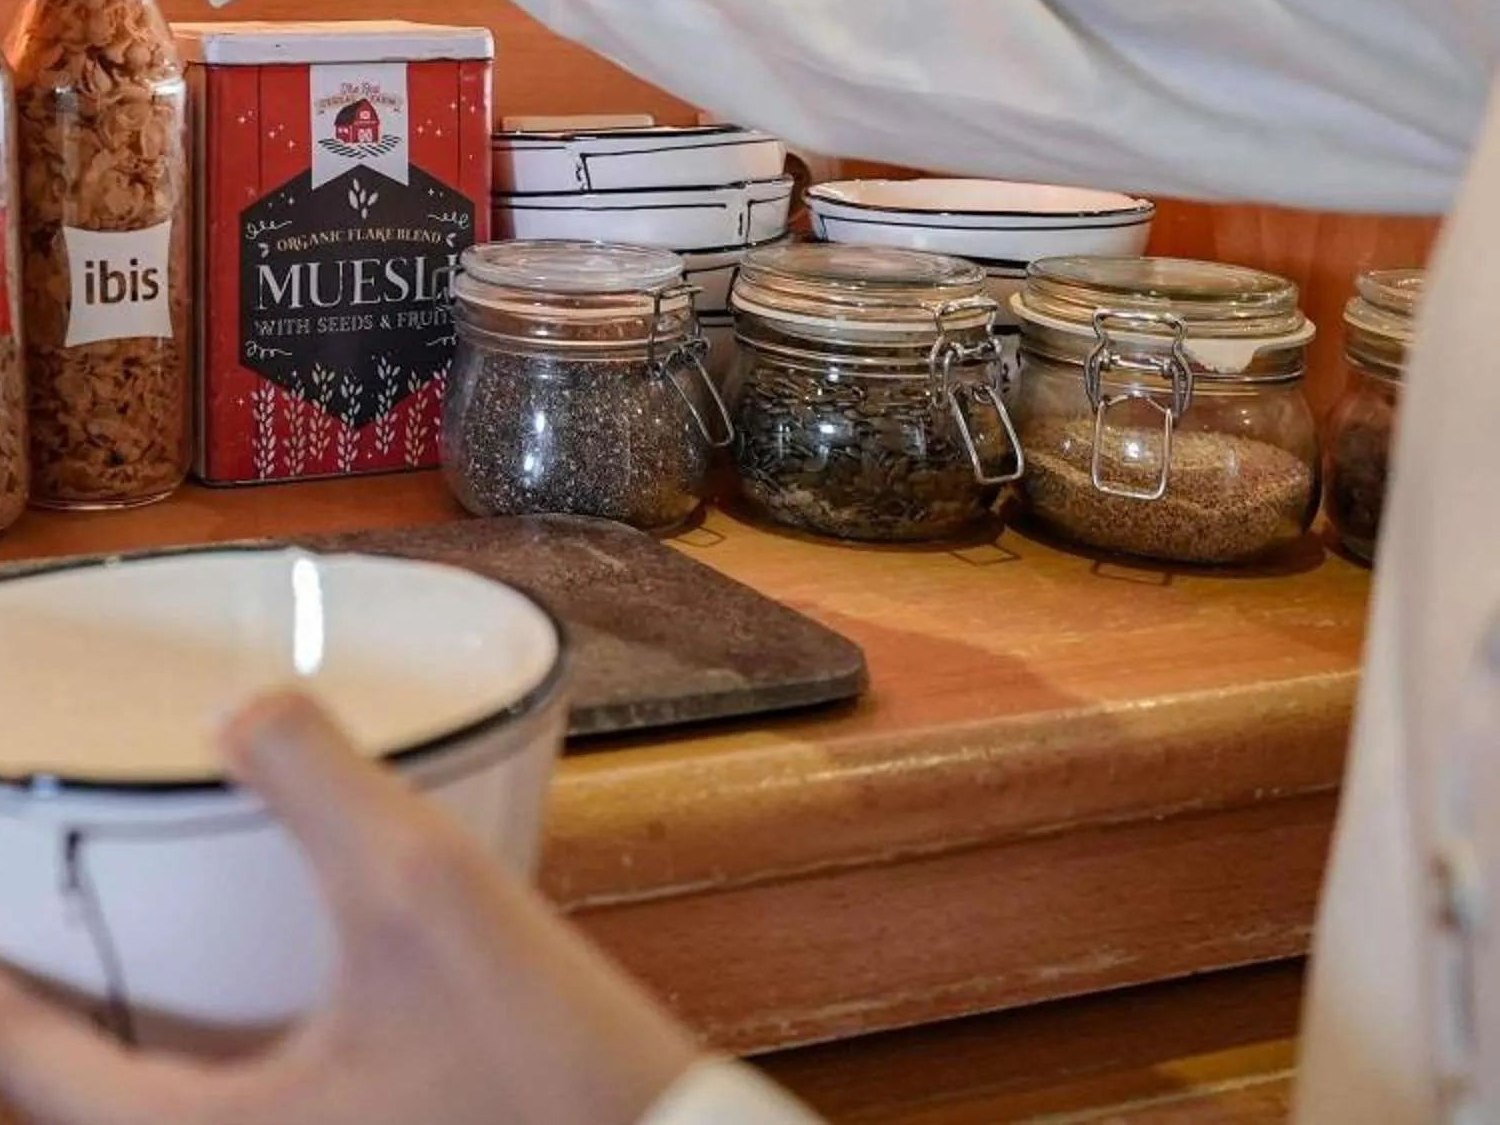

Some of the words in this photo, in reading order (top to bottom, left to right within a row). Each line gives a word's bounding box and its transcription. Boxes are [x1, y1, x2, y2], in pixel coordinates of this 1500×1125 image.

[348, 227, 393, 243] FLAKE
[396, 227, 442, 244] BLEND
[83, 258, 161, 305] ibis
[255, 318, 311, 336] WITH
[317, 315, 374, 334] SEEDS
[379, 314, 393, 330] &
